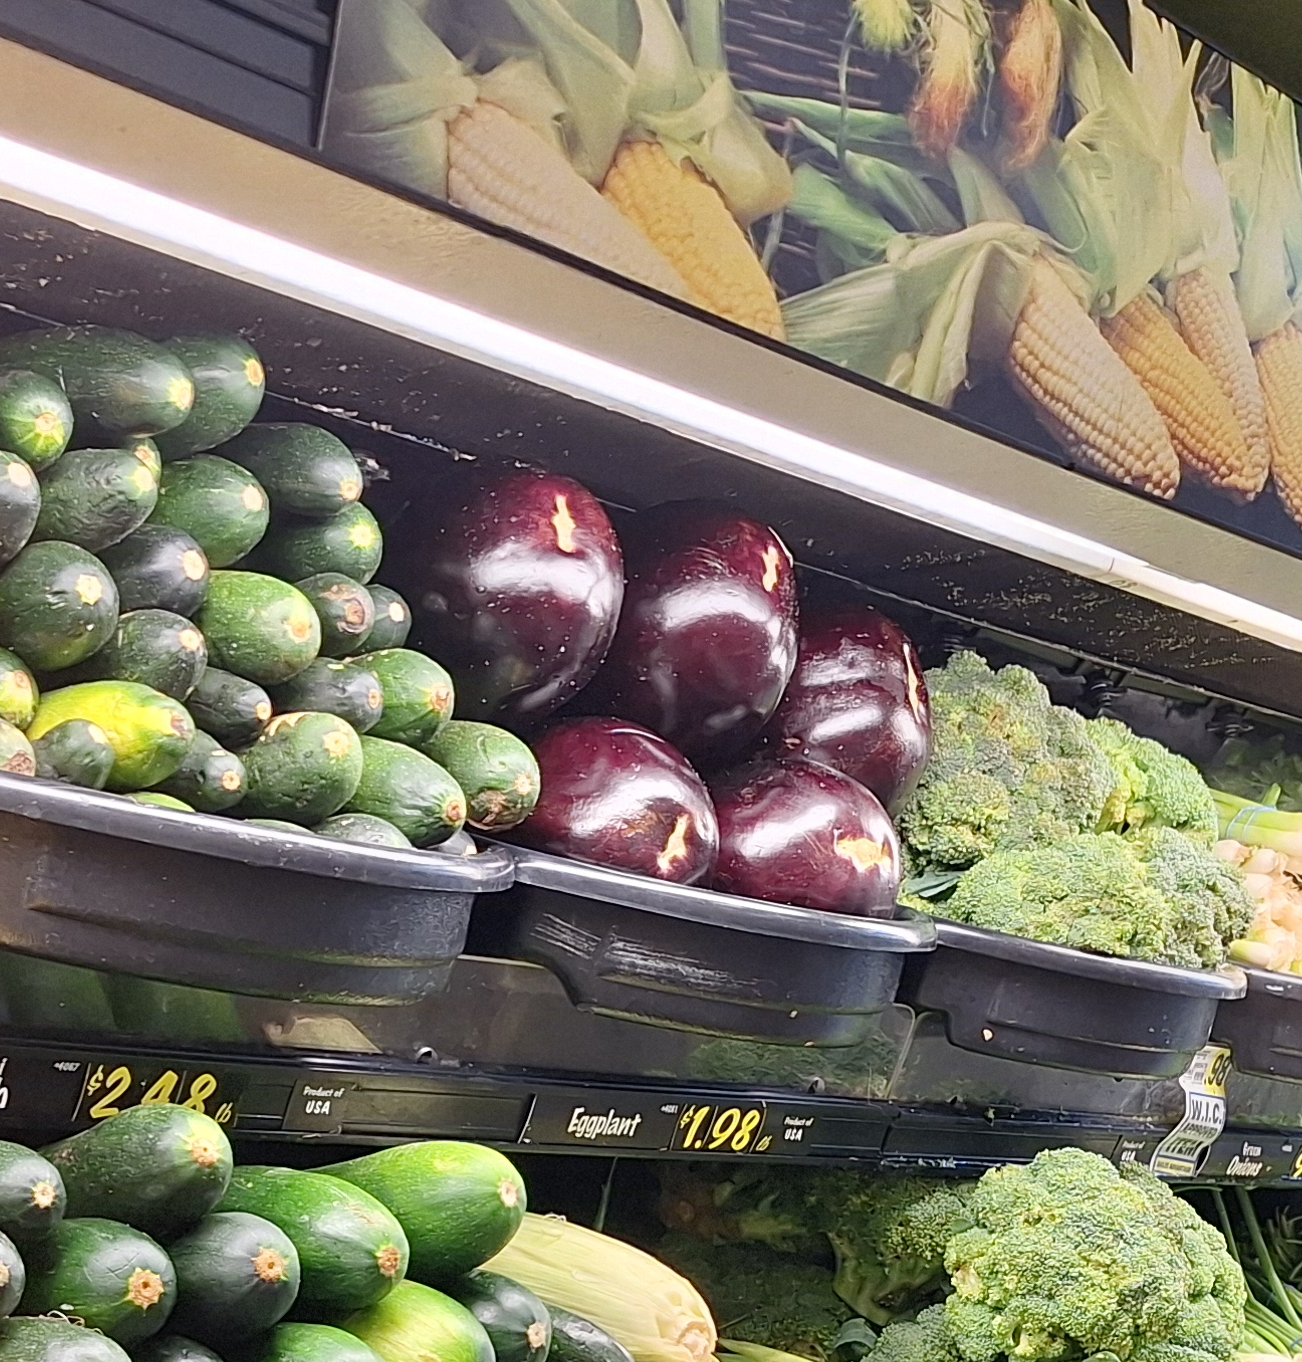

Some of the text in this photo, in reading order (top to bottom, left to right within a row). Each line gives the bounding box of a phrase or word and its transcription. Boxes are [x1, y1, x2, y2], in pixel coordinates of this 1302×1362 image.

[303, 1086, 345, 1097] Product of
[305, 1100, 331, 1115] USA
[568, 1107, 641, 1139] Eggplant
[680, 1105, 760, 1151] $1.98
[784, 1128, 803, 1141] USA
[1226, 1155, 1263, 1176] Onions
